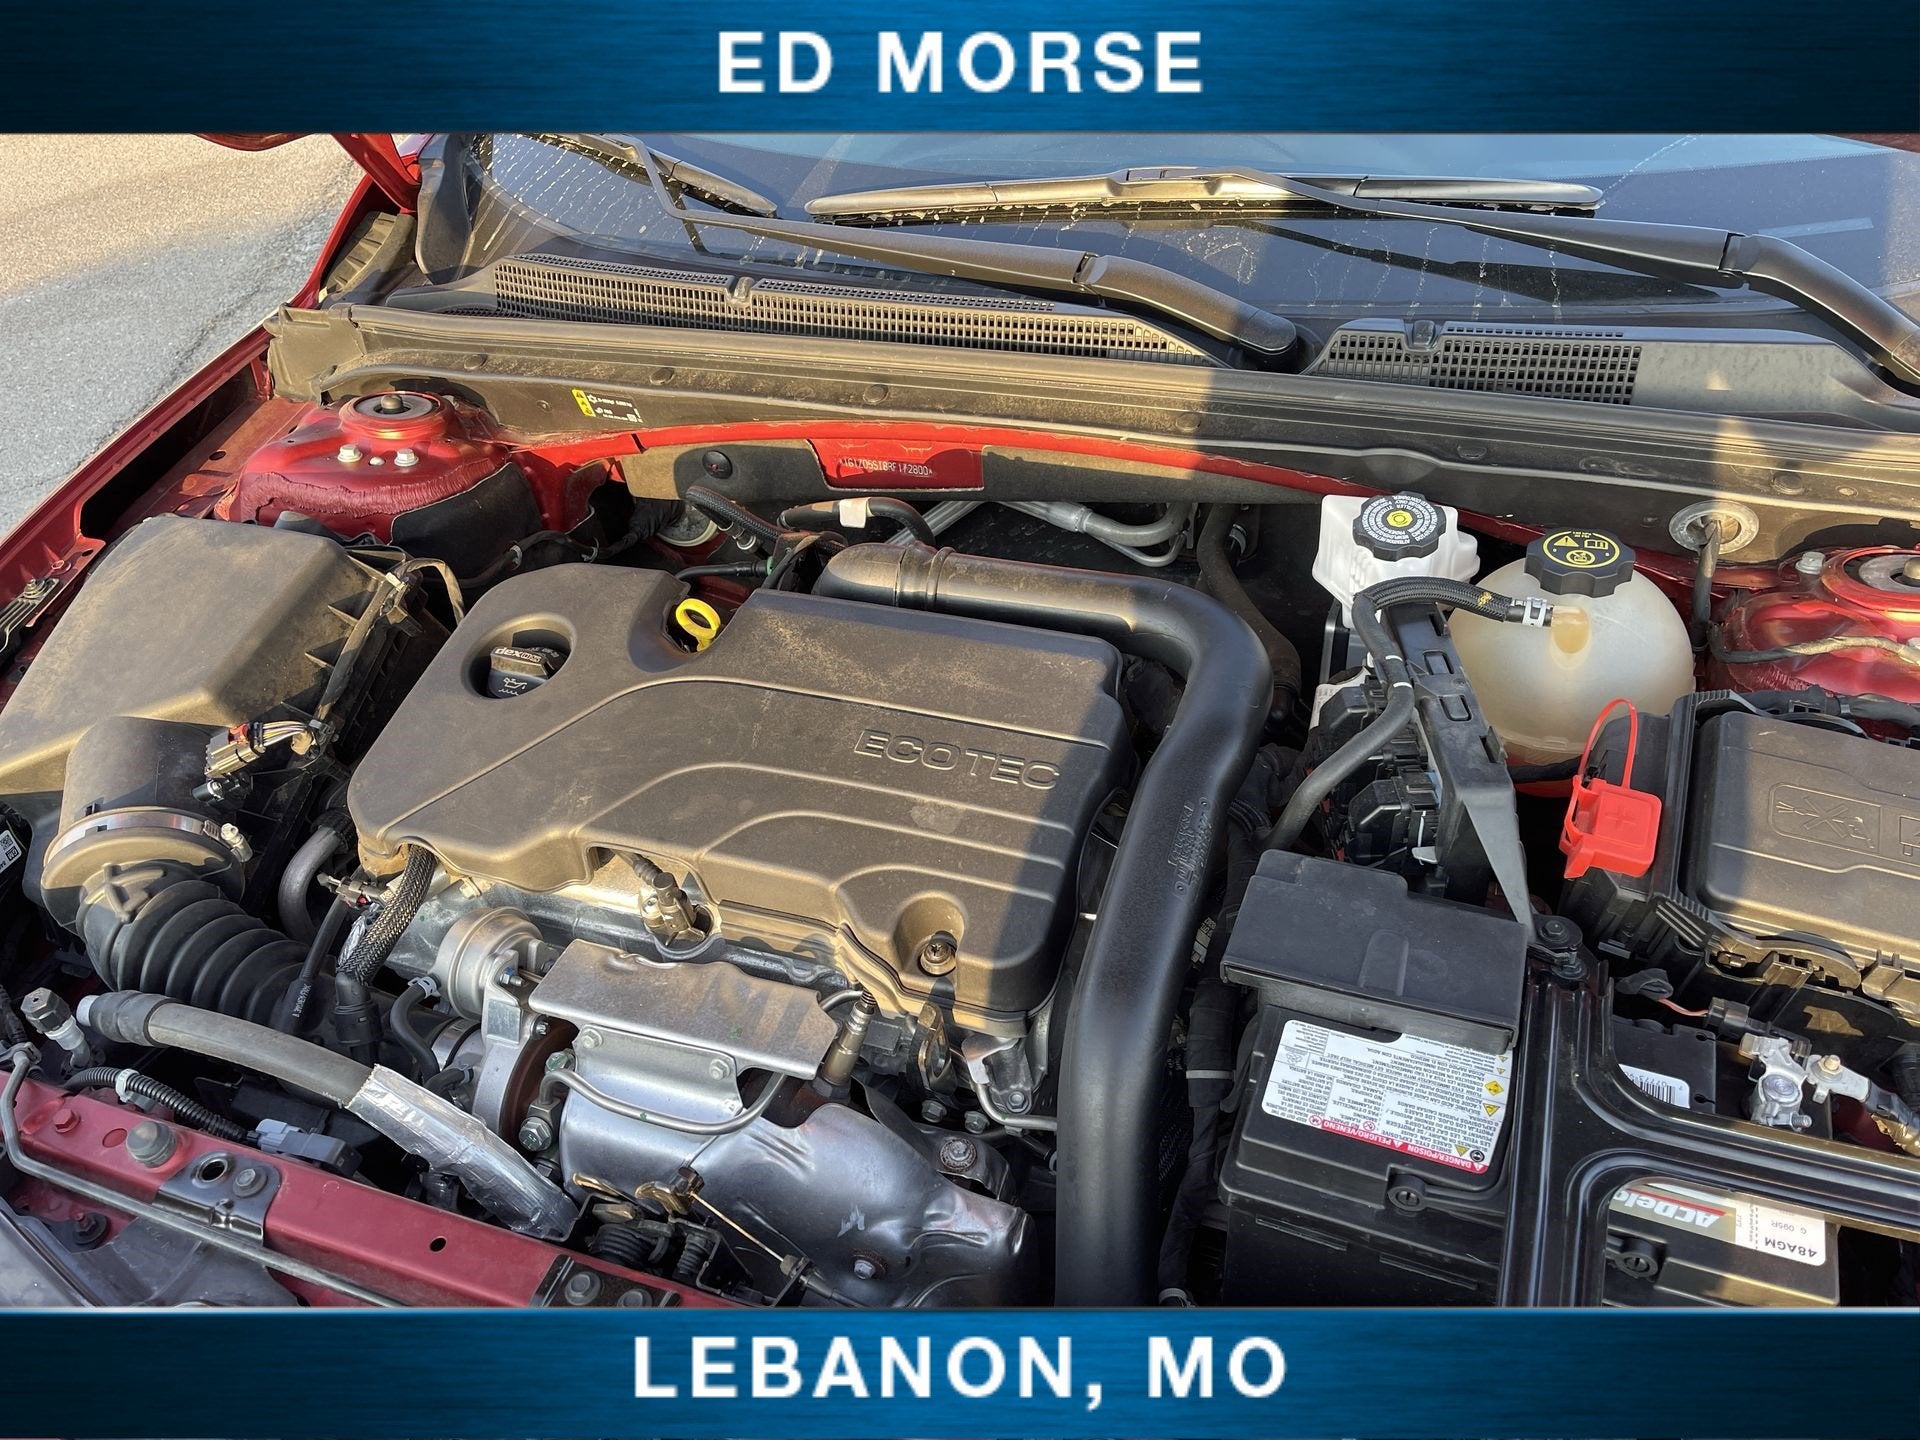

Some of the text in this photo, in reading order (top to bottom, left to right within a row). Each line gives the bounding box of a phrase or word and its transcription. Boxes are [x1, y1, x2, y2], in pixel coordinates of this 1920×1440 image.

[854, 728, 1060, 790] ECOTEC
[1322, 1120, 1472, 1168] DANGER/POISON PELIGRO/VENENO
[1381, 1129, 1412, 1142] EXPLOSIVE
[1614, 1191, 1719, 1228] ACDelc
[1765, 1237, 1816, 1258] 48AGM
